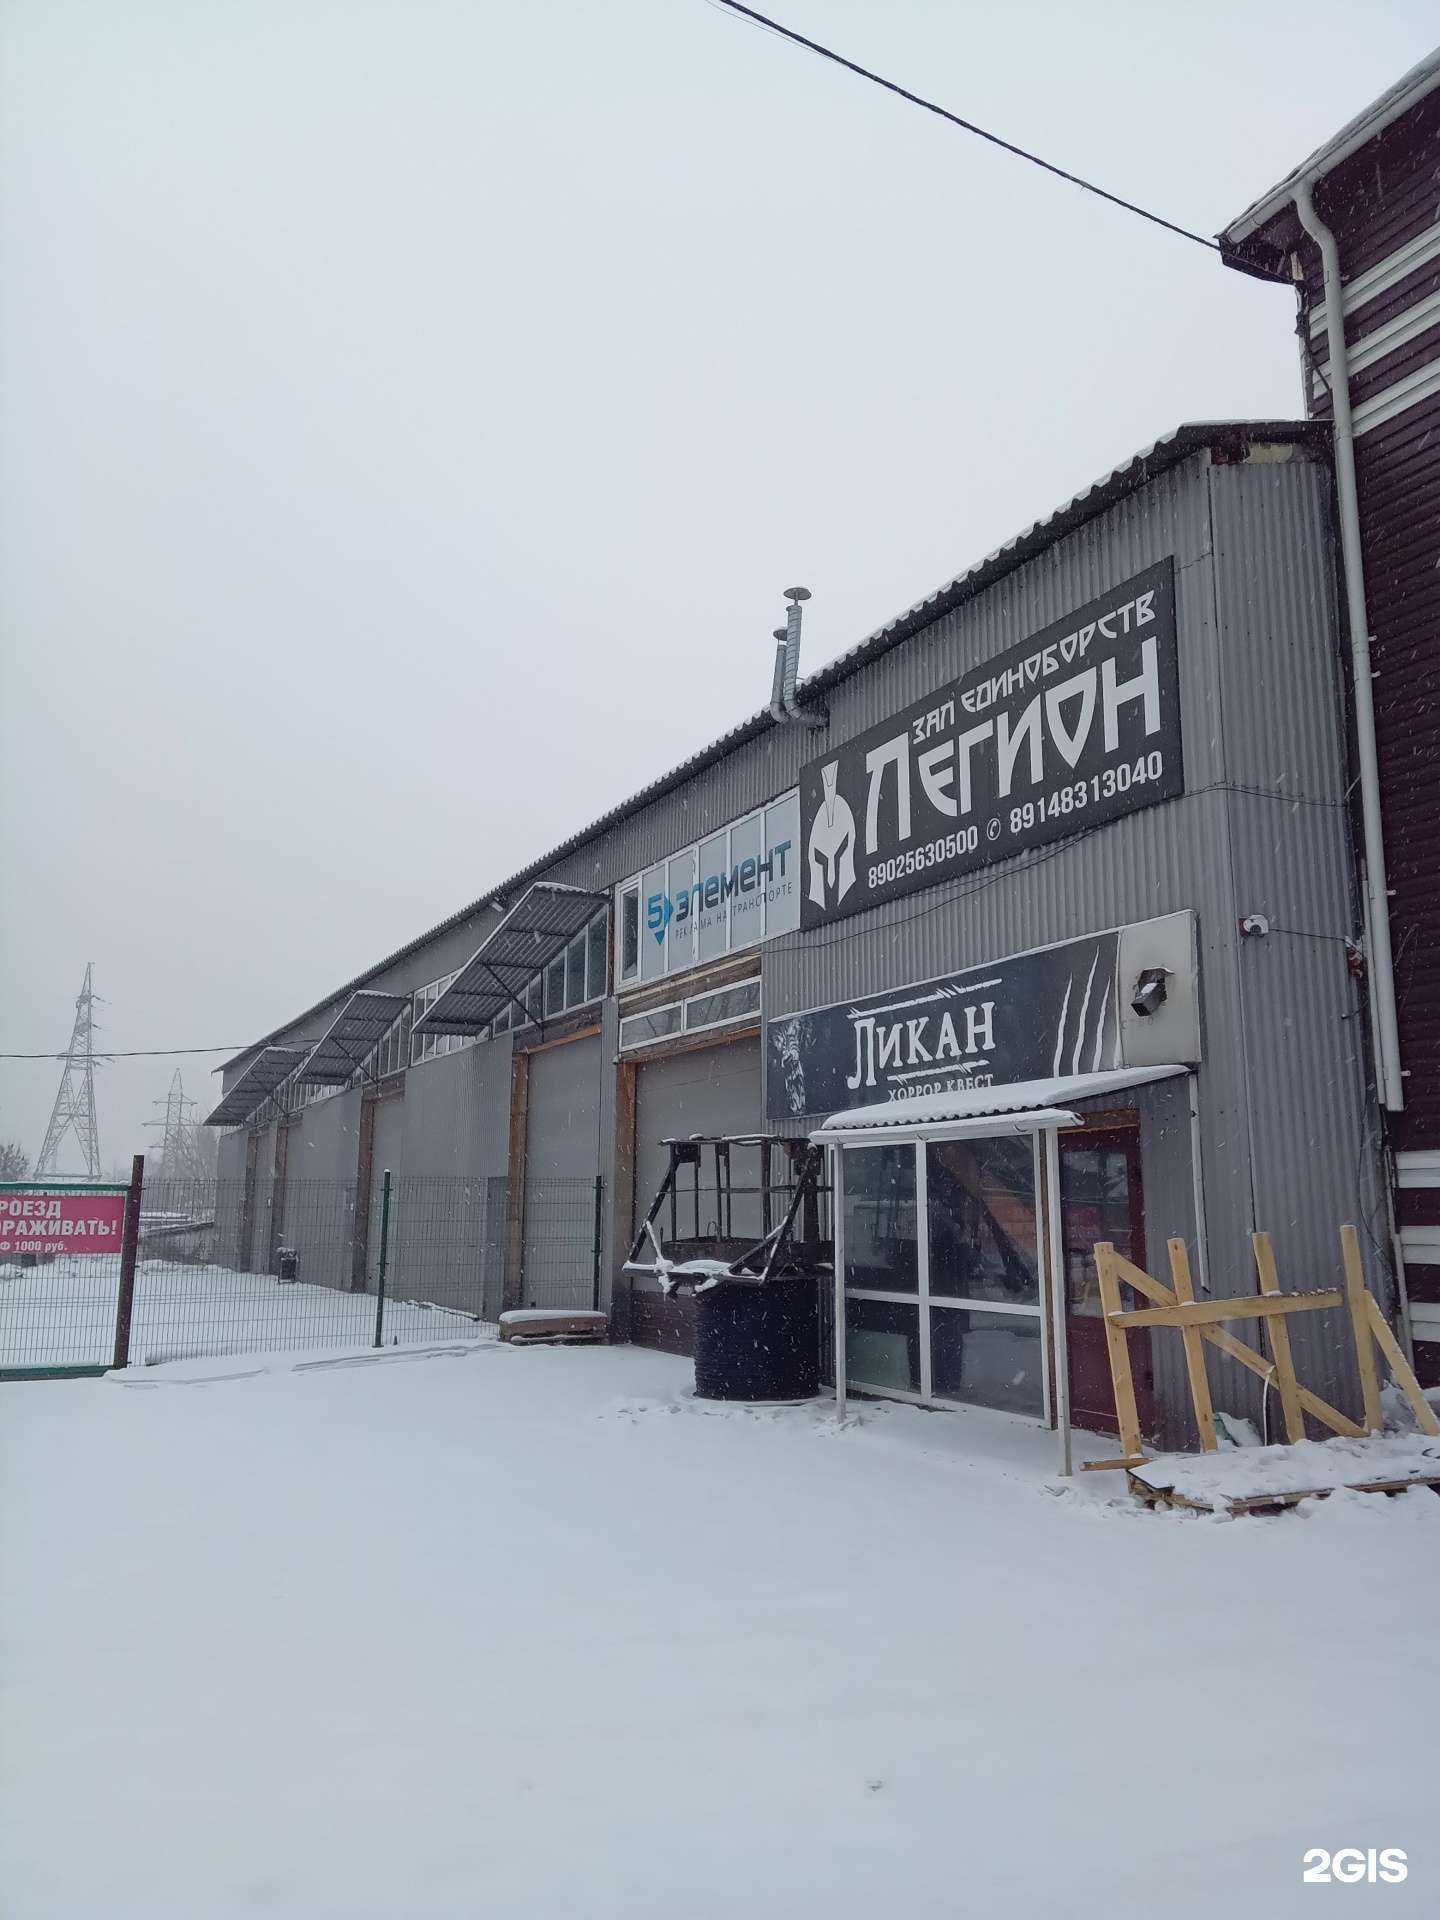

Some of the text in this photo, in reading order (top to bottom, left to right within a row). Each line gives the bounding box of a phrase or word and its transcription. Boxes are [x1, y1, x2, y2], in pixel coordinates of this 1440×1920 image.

[913, 590, 1155, 744] ЗАЛ ЕДИНОБОРСТВ
[866, 636, 1161, 855] ЛЕГИОН
[868, 750, 1163, 889] 89025630500 89148313040
[647, 893, 663, 929] 5
[888, 1073, 994, 1104] ХОРРОР КВЕСТ
[0, 1219, 117, 1236] РАЖИВАТЬ!
[15, 1240, 42, 1251] 1000
[45, 1240, 68, 1253] руб.
